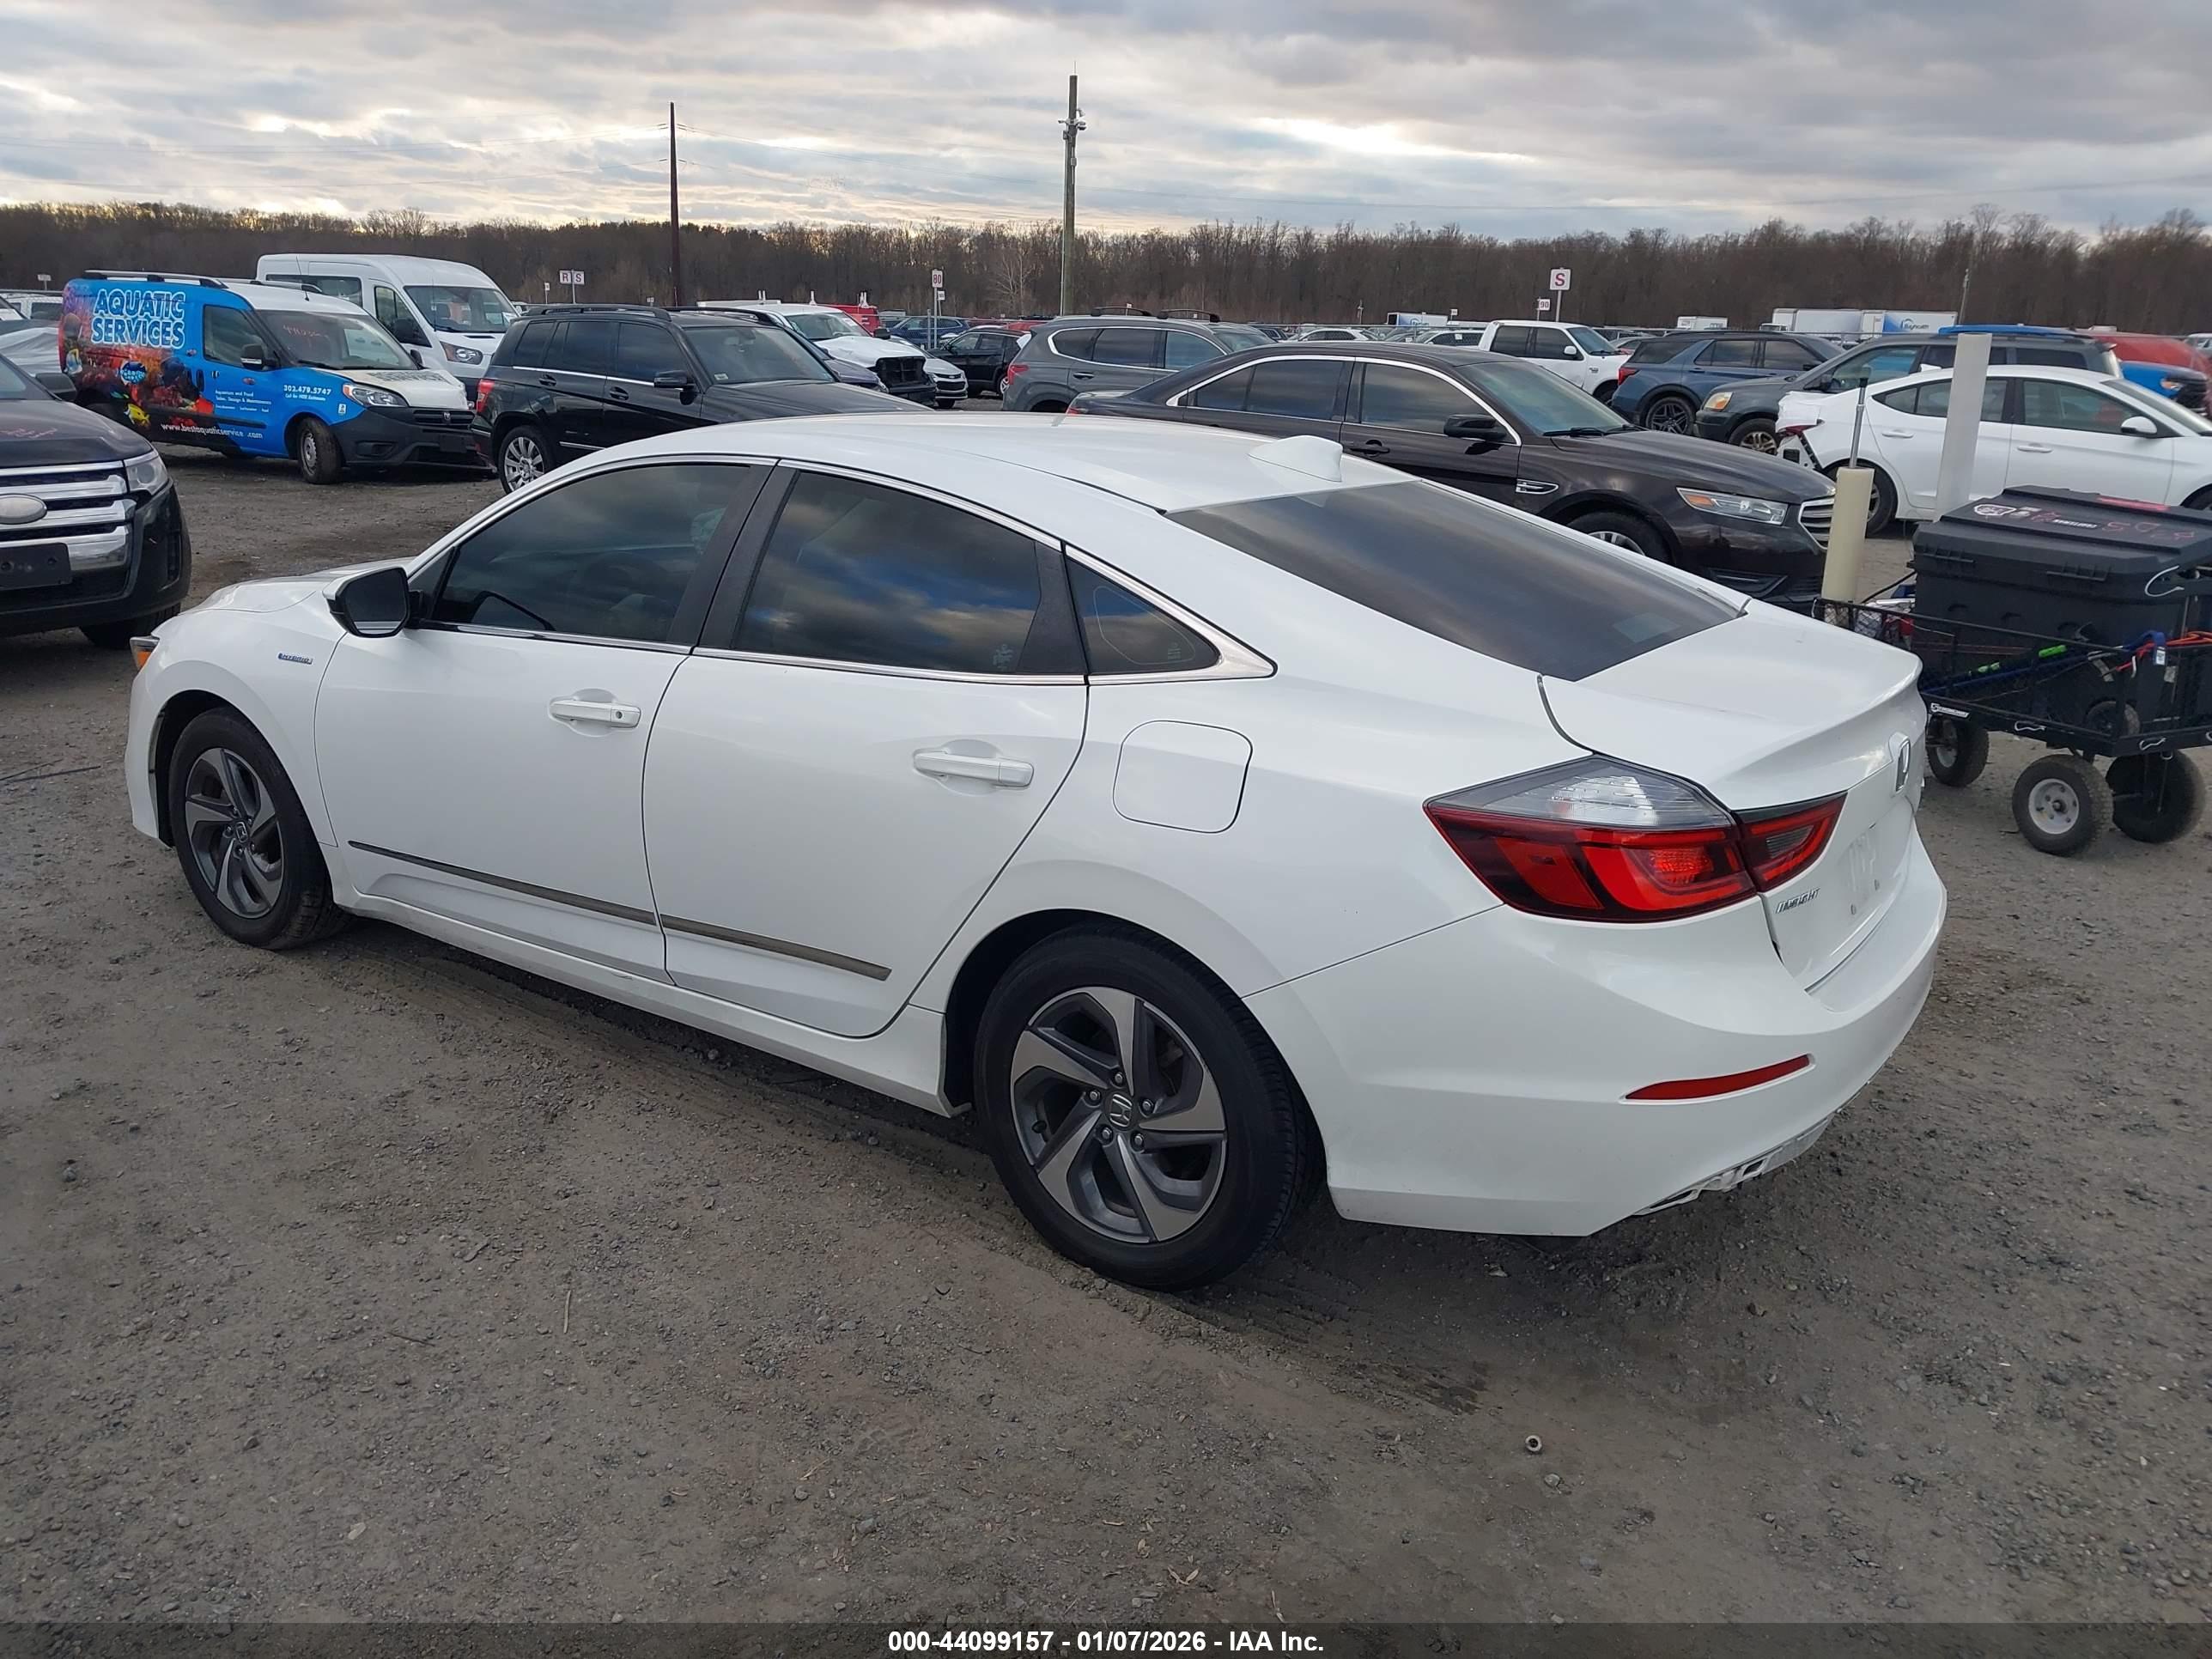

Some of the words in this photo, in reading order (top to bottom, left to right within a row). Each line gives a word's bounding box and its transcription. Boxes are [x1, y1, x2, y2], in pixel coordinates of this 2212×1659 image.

[562, 272, 569, 283] R
[575, 273, 582, 283] S
[933, 274, 942, 284] 80
[1555, 272, 1565, 287] S
[94, 289, 185, 319] AQUATIC
[91, 318, 185, 349] SERVICES
[283, 385, 331, 395] 302.479.5747
